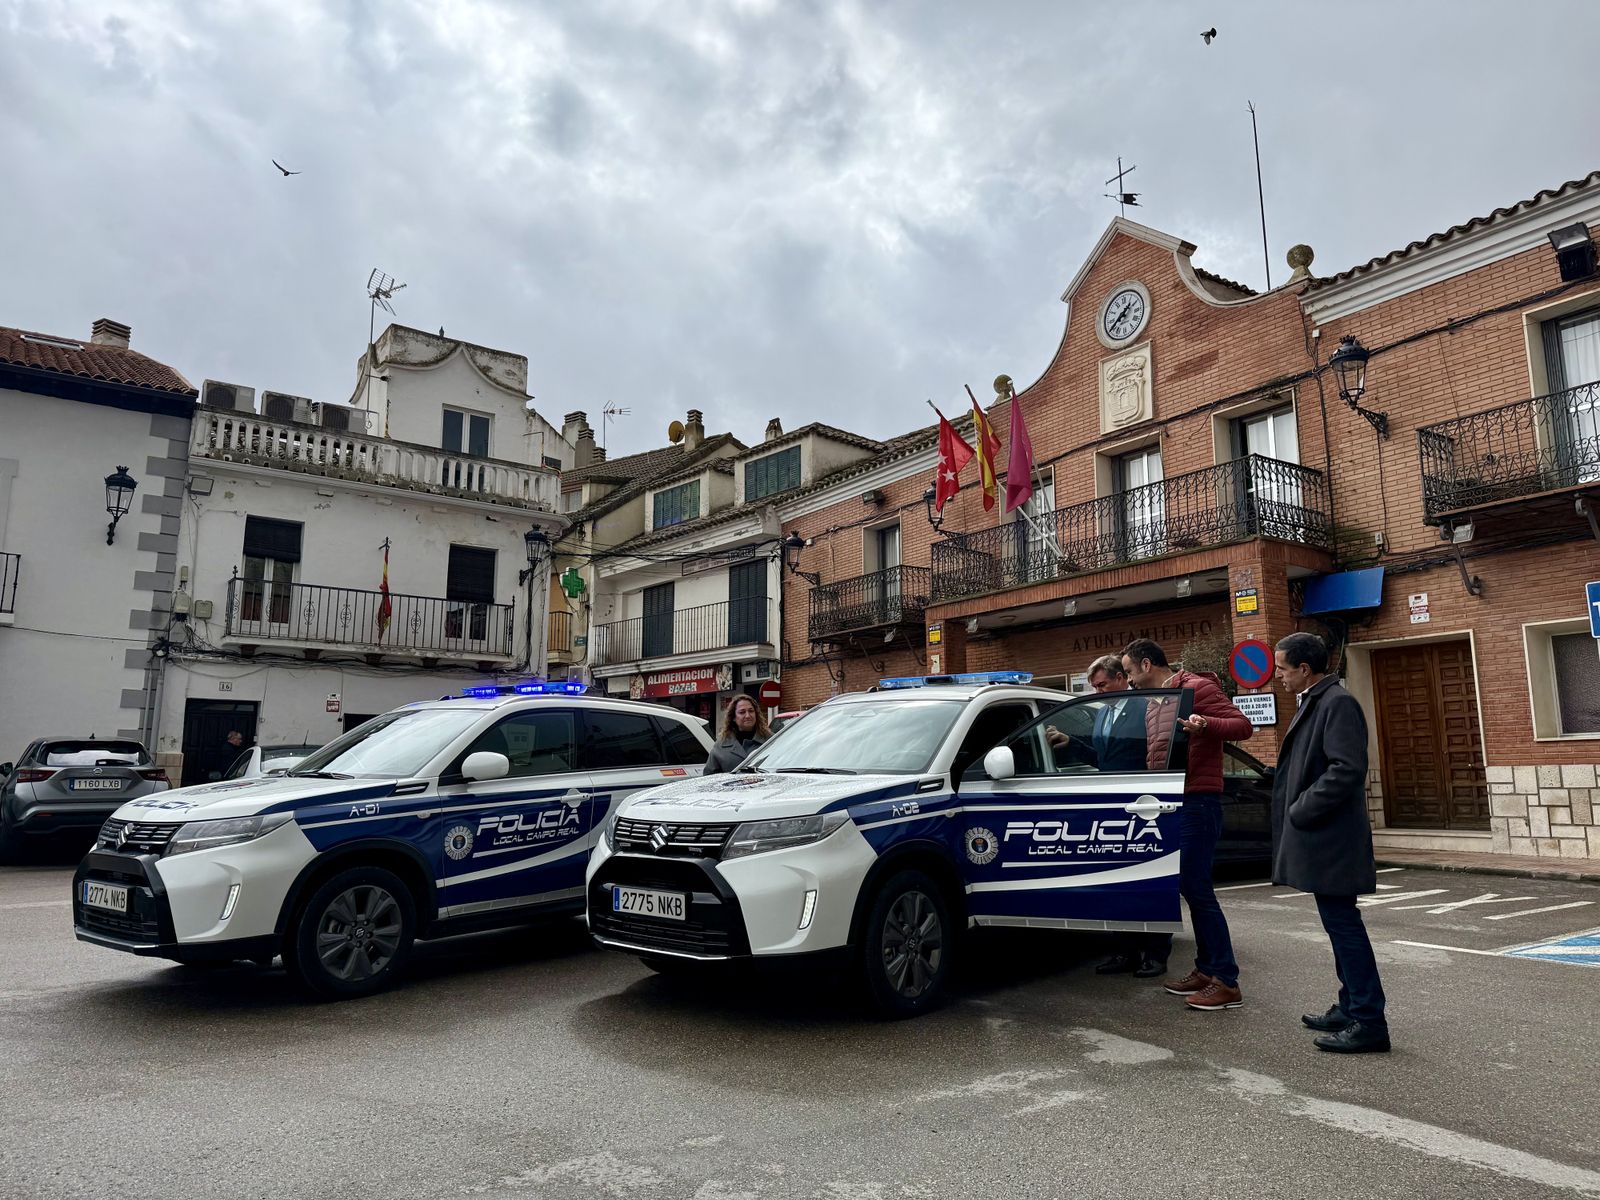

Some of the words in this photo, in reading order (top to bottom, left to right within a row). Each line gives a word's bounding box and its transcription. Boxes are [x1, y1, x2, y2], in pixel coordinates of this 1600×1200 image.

[1073, 620, 1212, 652] AYUNTAMIENTO
[647, 669, 714, 685] ALIMENTACION
[668, 682, 698, 694] BAZAR
[78, 780, 101, 788] 1160
[102, 780, 120, 788] LXB
[493, 834, 523, 845] LOCAL
[526, 829, 556, 841] CAMPO
[557, 827, 580, 837] REAL
[1028, 845, 1072, 855] LOCAL
[1077, 844, 1123, 854] CAMPO
[1126, 843, 1164, 852] REAL
[89, 886, 109, 906] 2774
[110, 889, 126, 909] NKB
[622, 891, 654, 912] 2775
[658, 895, 683, 917] NKB
